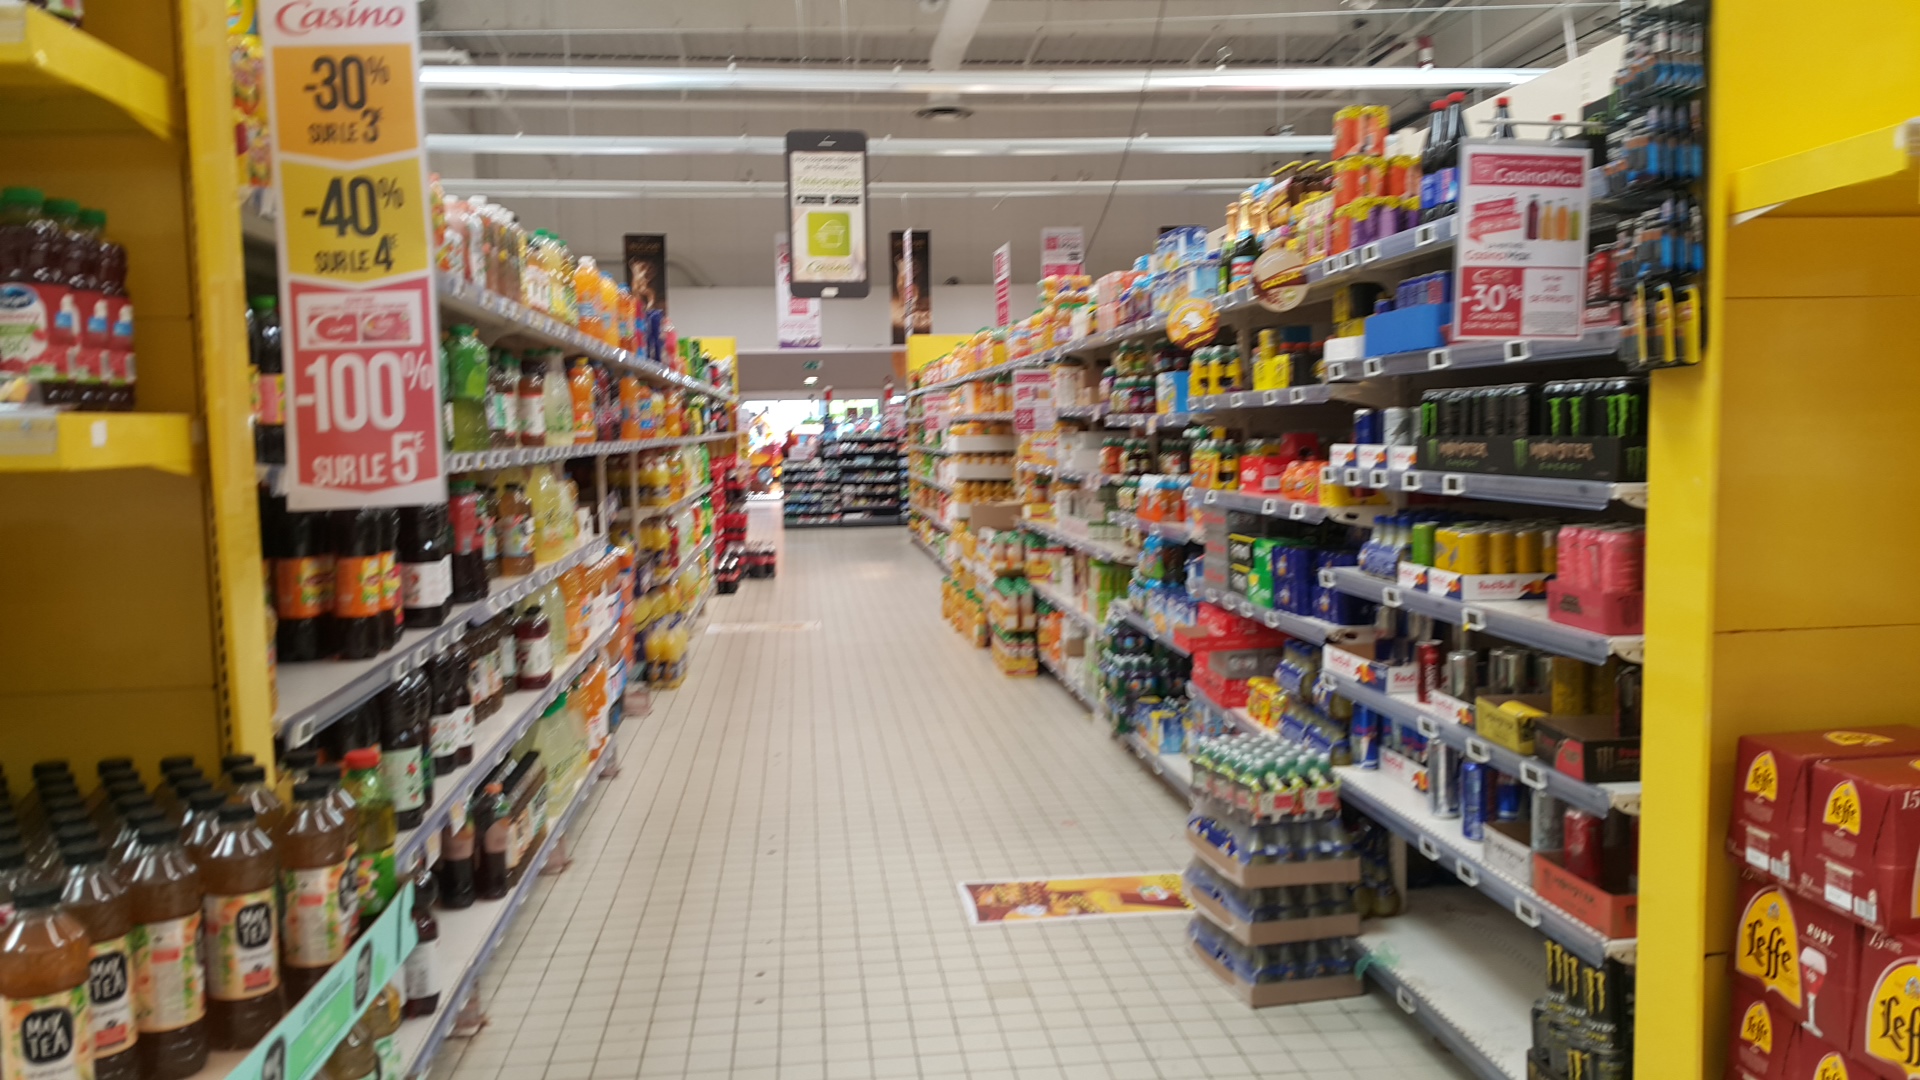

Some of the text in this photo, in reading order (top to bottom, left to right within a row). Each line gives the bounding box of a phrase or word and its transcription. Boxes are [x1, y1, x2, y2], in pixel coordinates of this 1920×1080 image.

[275, 0, 406, 37] Casino
[303, 54, 391, 111] -30%
[308, 122, 337, 144] SUR
[340, 121, 358, 143] LE
[302, 175, 404, 237] -40%
[314, 252, 346, 274] SUR
[350, 250, 370, 272] LE
[1460, 283, 1523, 313] -30%
[296, 351, 434, 433] -100%
[311, 455, 355, 487] SUR
[359, 452, 388, 485] LE
[1746, 919, 1792, 980] Leffe
[1806, 922, 1835, 946] RUBY
[26, 1011, 63, 1039] MAY
[27, 1025, 70, 1059] TEA
